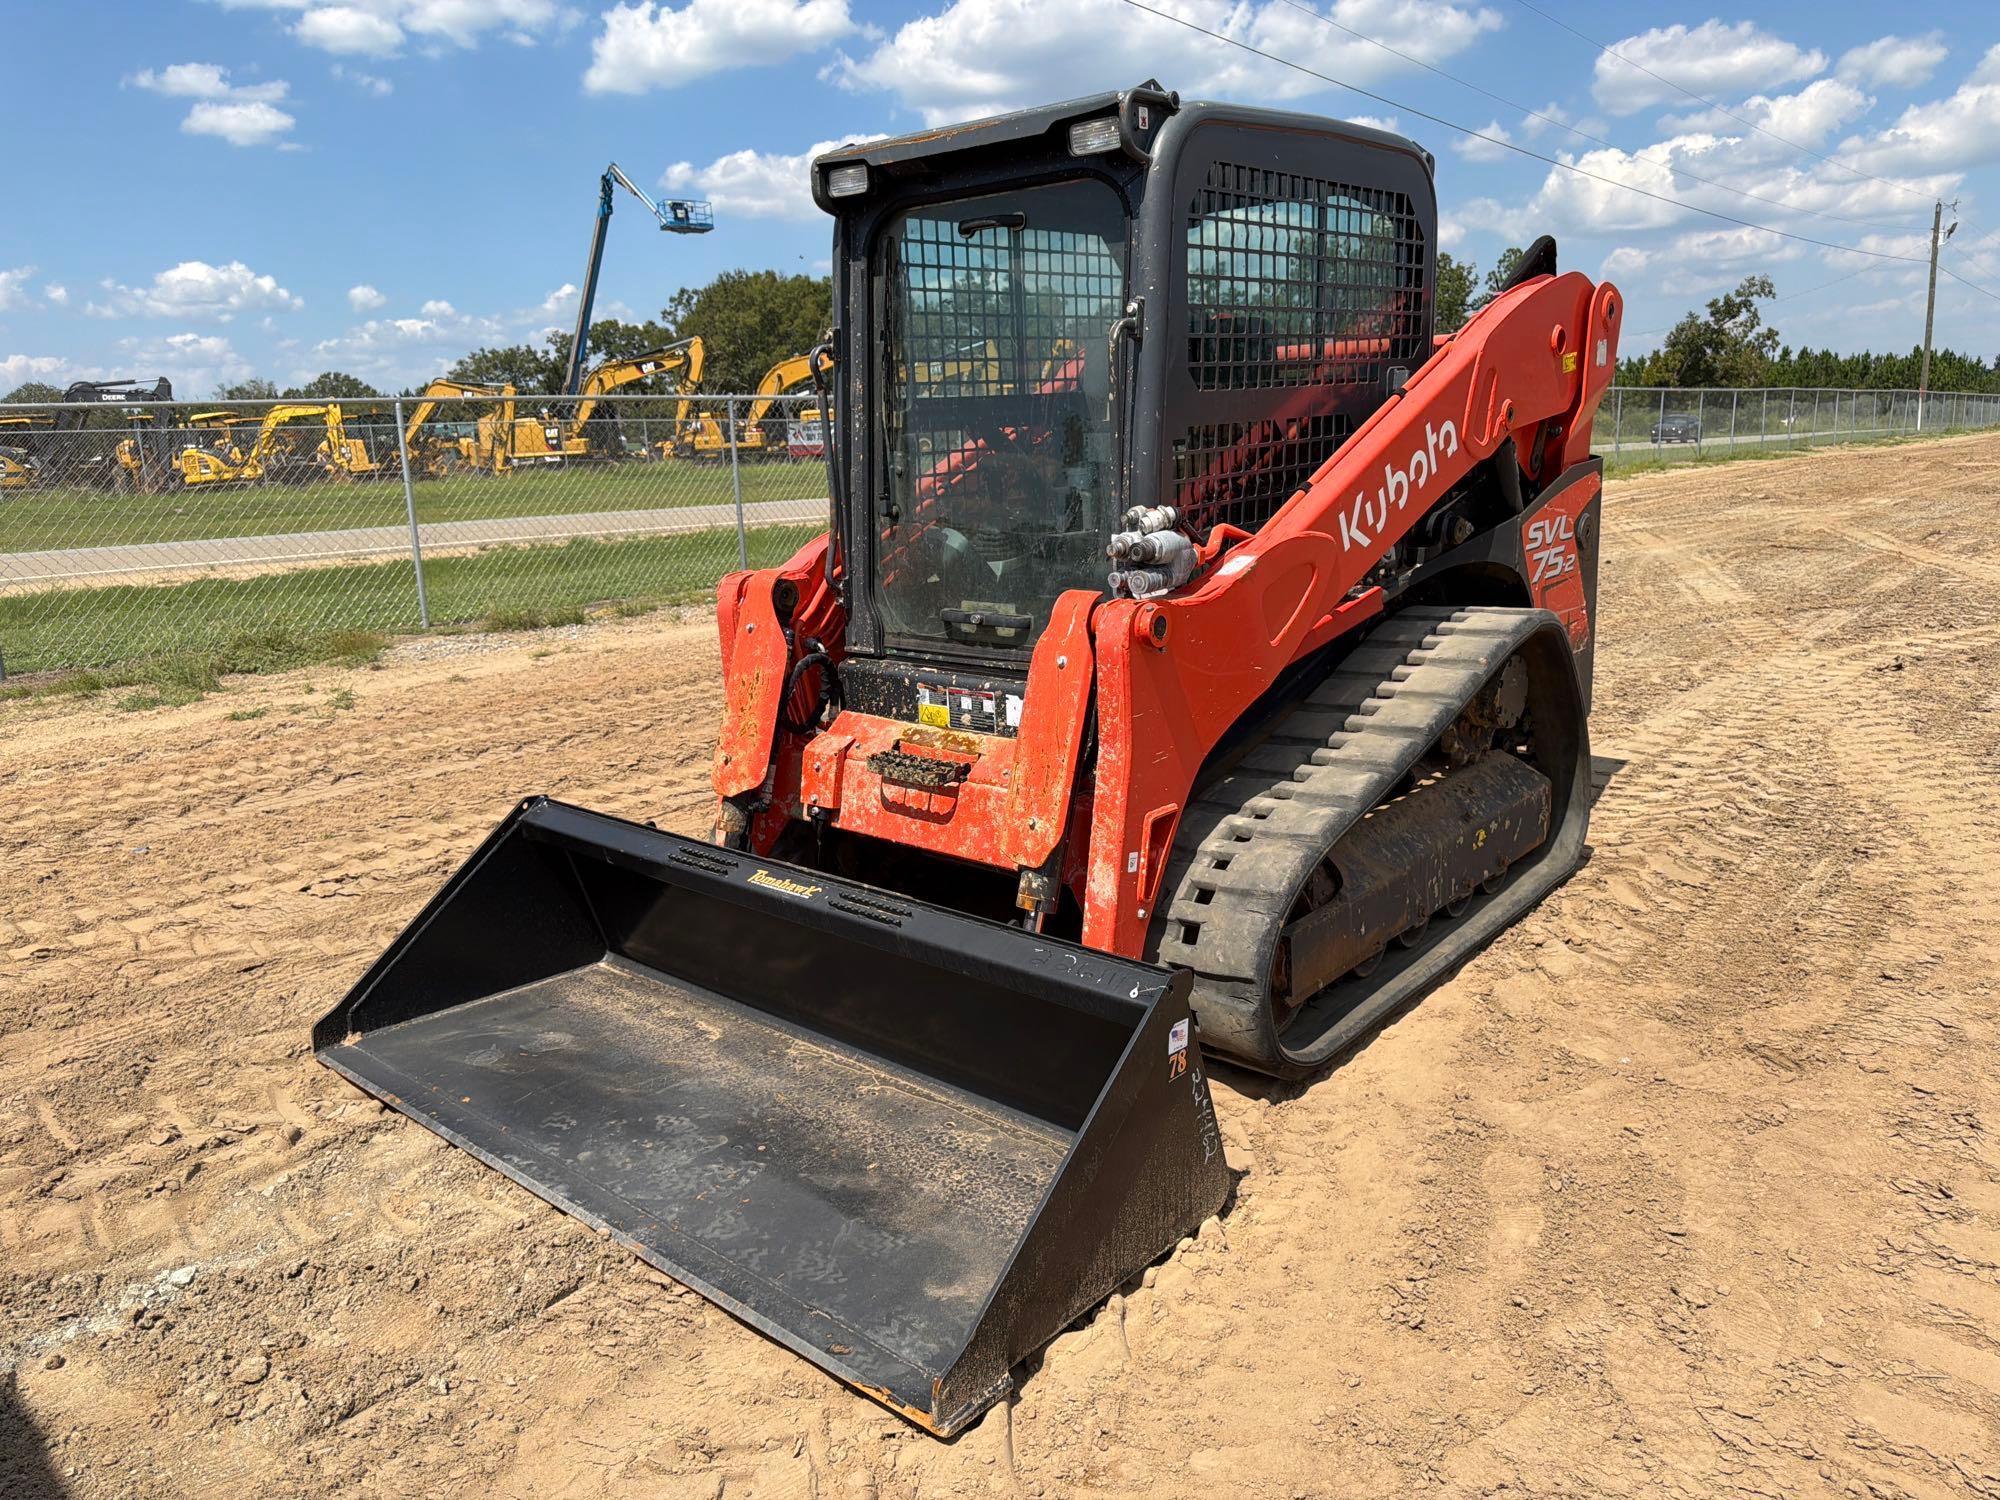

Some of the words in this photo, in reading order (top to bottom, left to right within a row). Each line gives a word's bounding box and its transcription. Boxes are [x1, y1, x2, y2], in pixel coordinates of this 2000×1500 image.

[641, 361, 656, 374] CAT
[545, 428, 559, 438] CAT
[1338, 420, 1459, 552] Kubota
[1526, 515, 1574, 550] SVL
[747, 869, 823, 897] Tomahawk
[1168, 1048, 1187, 1079] 78
